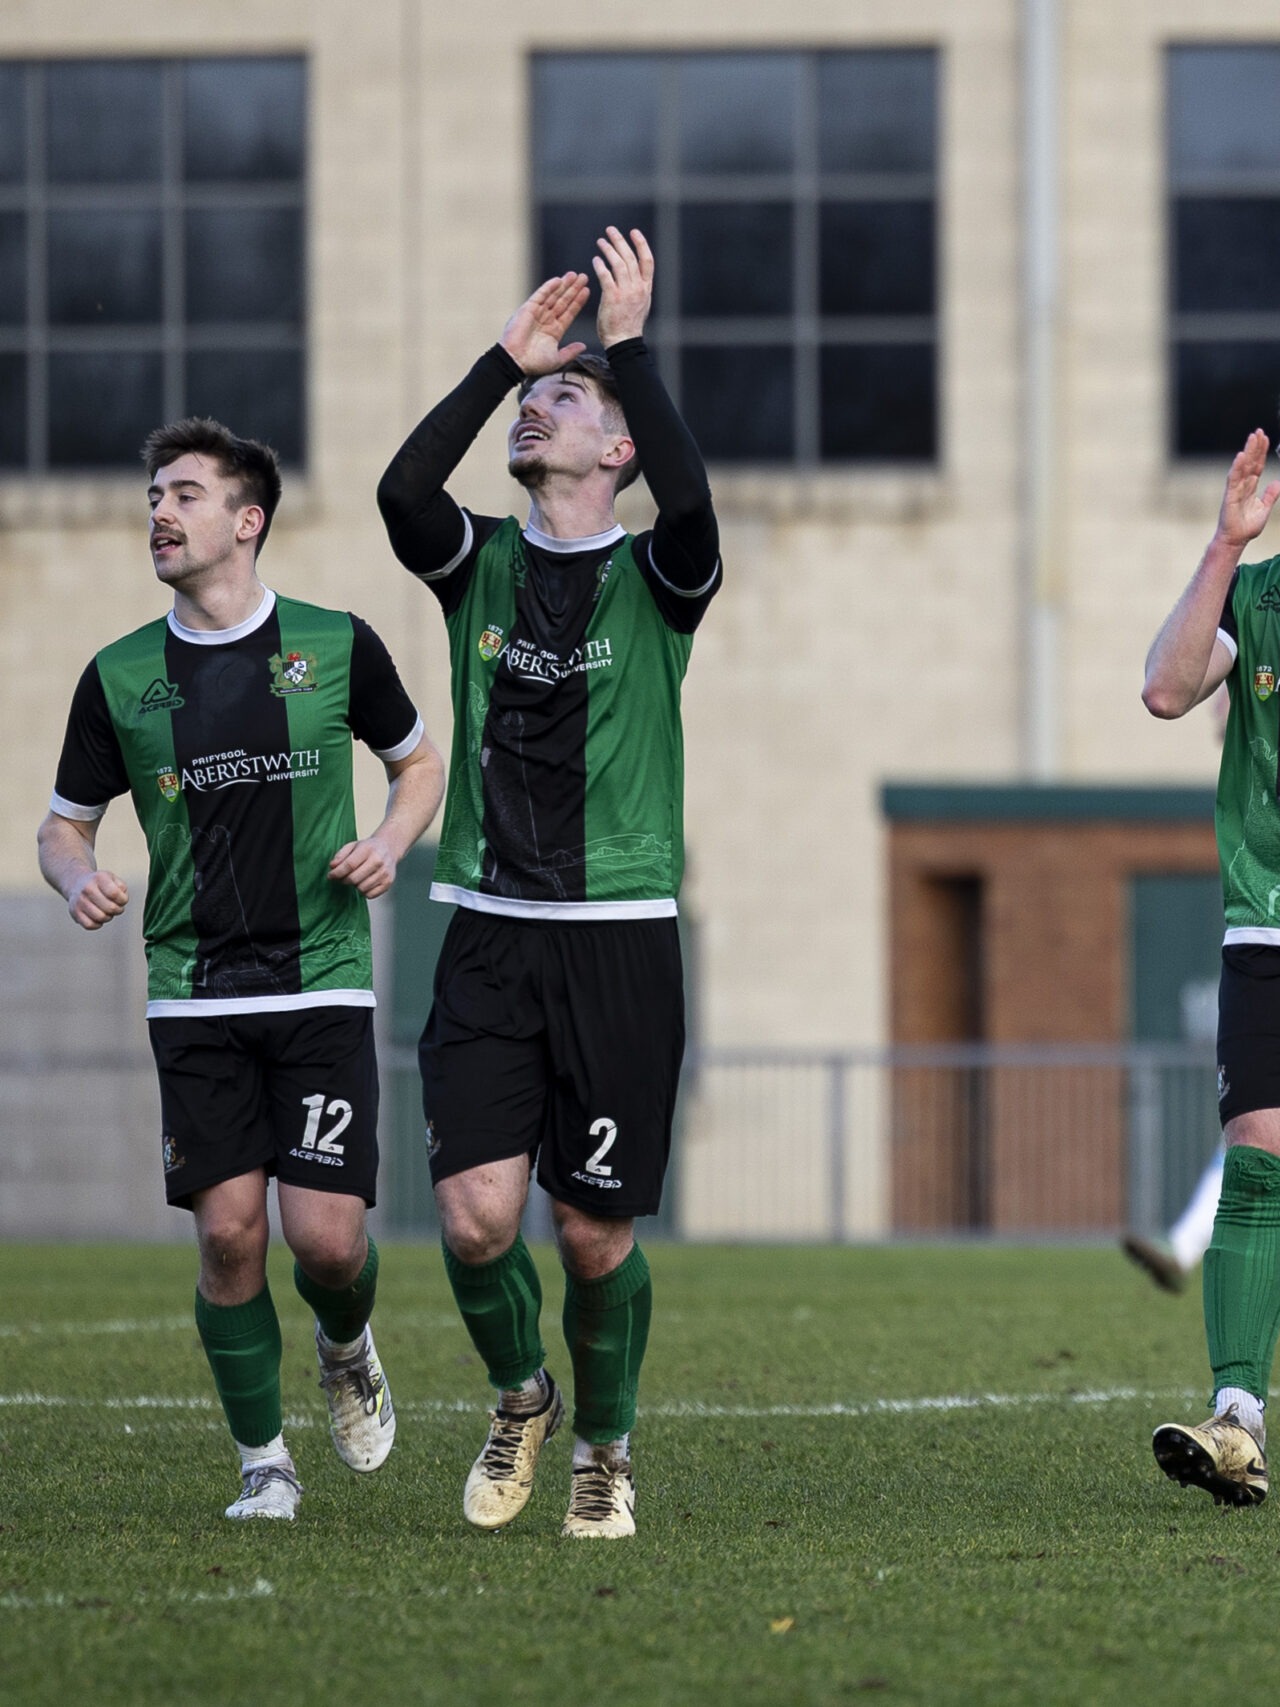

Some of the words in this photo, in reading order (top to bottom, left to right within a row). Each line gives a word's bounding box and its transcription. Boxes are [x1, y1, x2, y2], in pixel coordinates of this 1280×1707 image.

[516, 639, 559, 660] PRIFGOL
[181, 749, 320, 792] ABERYSTWYTH
[192, 749, 247, 766] PRIFYSGOL
[266, 768, 319, 782] UNIVERSITY
[301, 1093, 353, 1155] 12
[585, 1117, 618, 1176] 2
